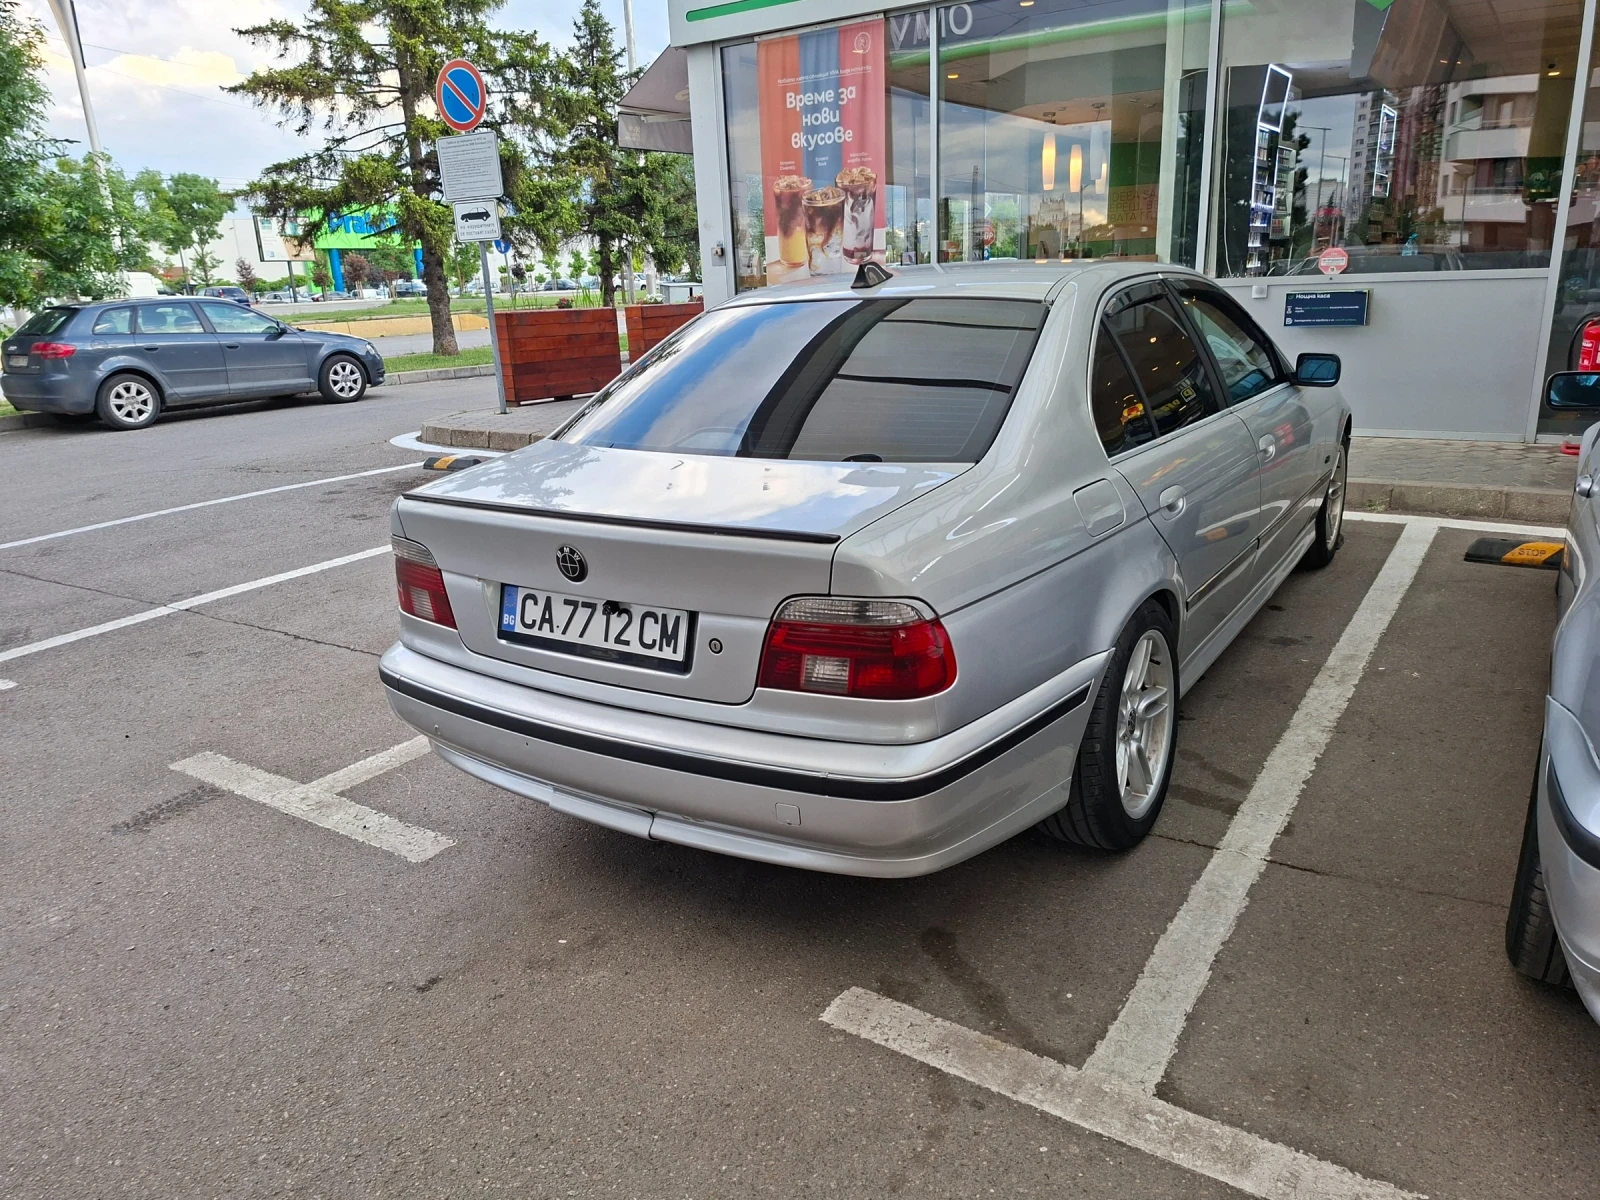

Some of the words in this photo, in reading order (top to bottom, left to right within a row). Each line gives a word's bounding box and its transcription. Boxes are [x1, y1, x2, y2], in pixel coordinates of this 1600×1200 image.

[786, 89, 835, 112] Време
[838, 85, 856, 105] за
[802, 107, 840, 127] нови
[791, 126, 853, 151] вкусове
[557, 547, 581, 561] BMW
[1518, 547, 1547, 557] STOP
[503, 614, 515, 625] BG
